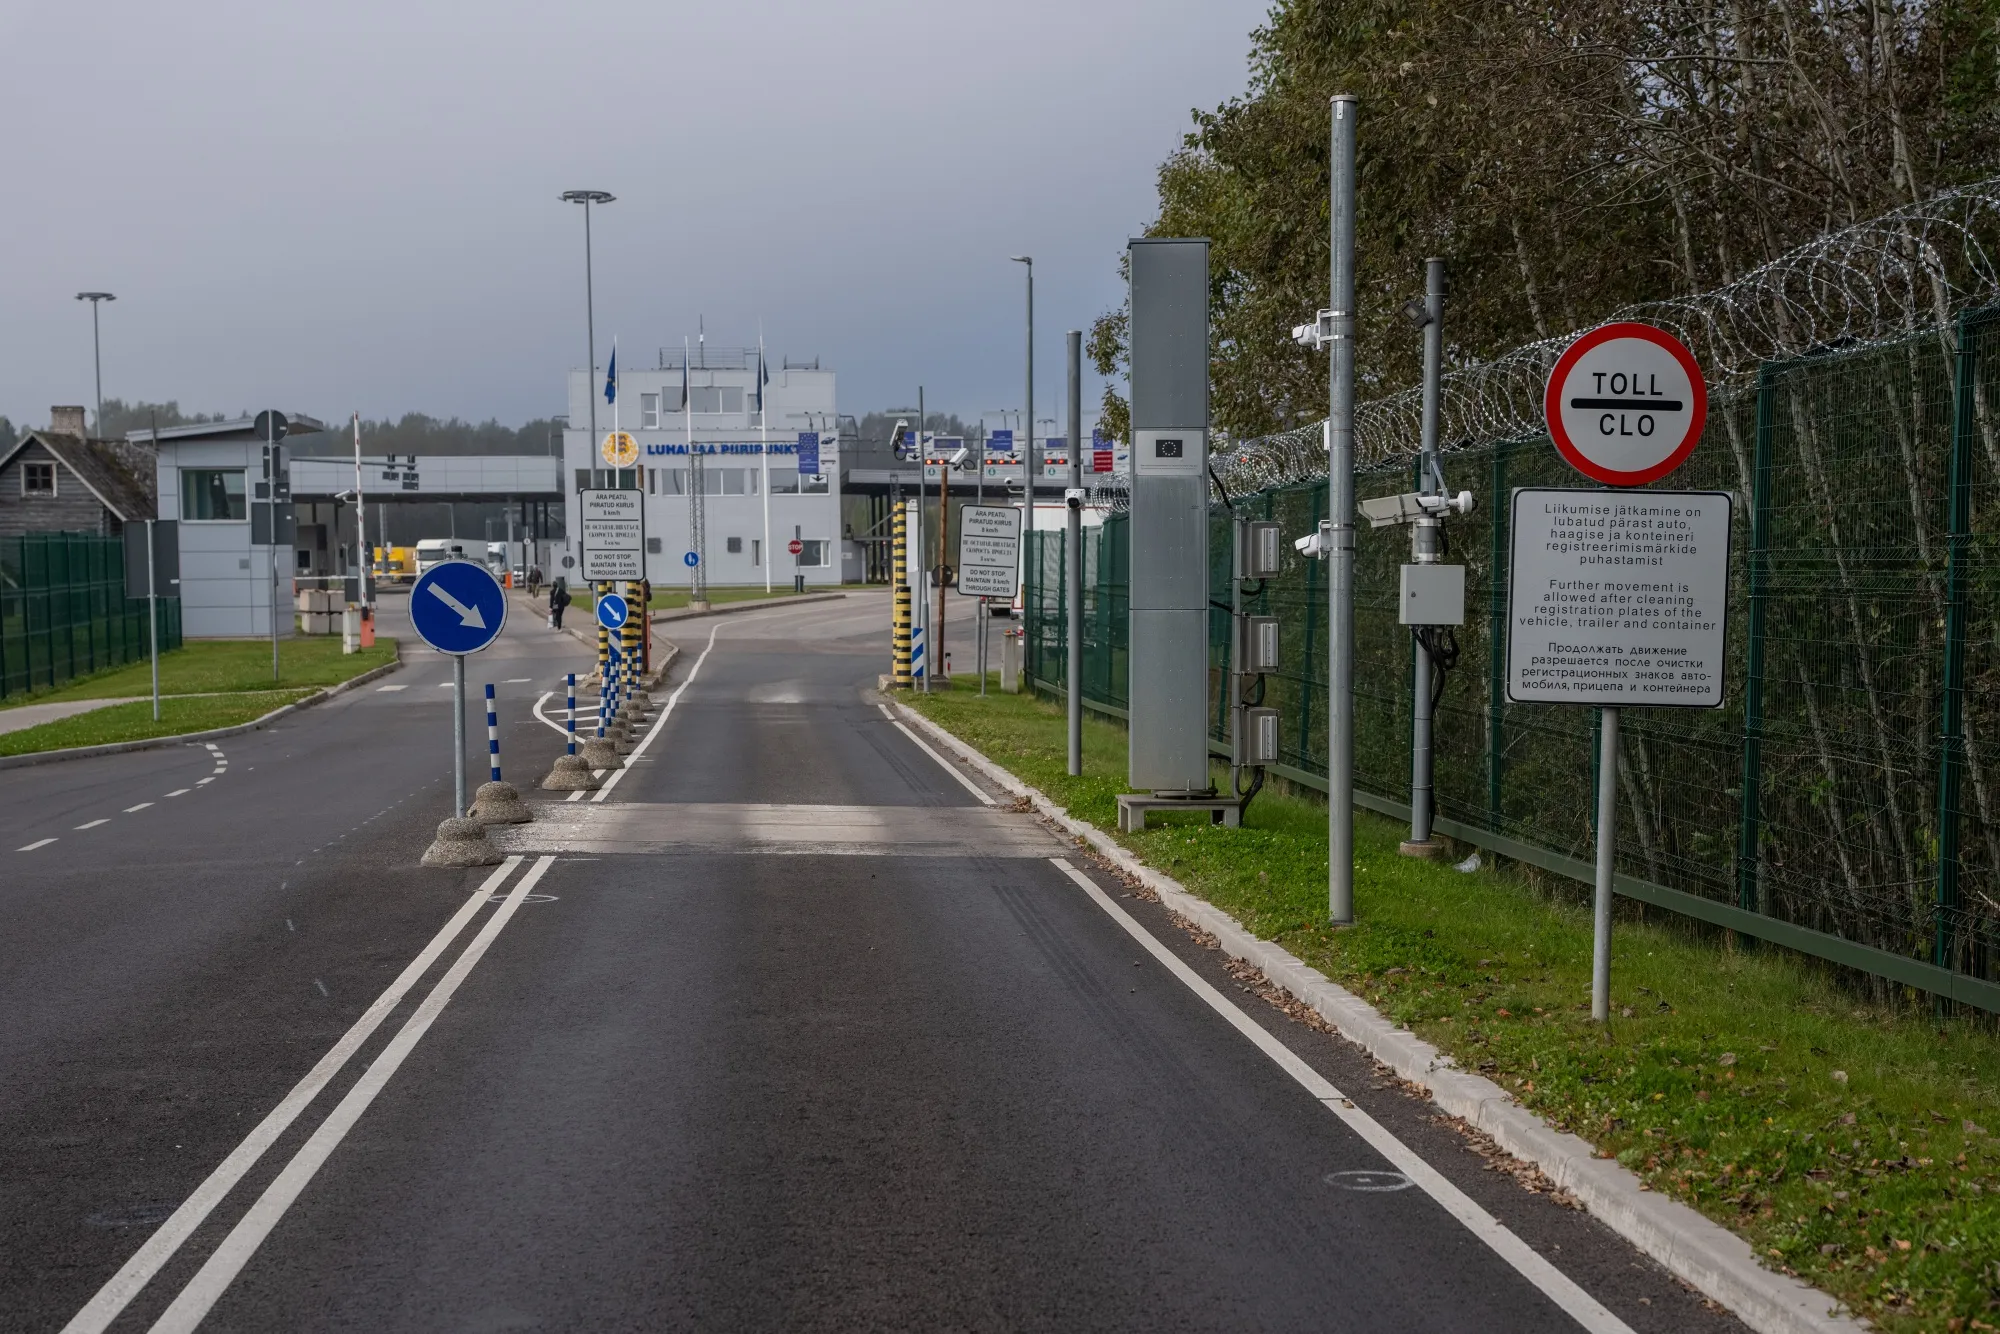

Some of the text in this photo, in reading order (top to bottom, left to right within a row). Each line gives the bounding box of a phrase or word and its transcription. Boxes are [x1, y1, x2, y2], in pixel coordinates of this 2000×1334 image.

[1593, 372, 1663, 396] TOLL
[1600, 414, 1654, 436] CLO
[1545, 504, 1701, 517] Liikumise jätkamine on
[1554, 517, 1691, 530] lubatud pärast auto,
[1550, 530, 1694, 542] haagise ja konteineri
[1546, 542, 1697, 554] registreerimismärkide
[1580, 555, 1663, 565] puhastamist
[1550, 580, 1689, 592] Further movement is
[1543, 593, 1694, 606] allowed after cleaning
[1534, 604, 1702, 617] registration plates of the
[1520, 616, 1716, 630] vehicle, trailer and container
[1548, 642, 1687, 655] Продолжать движение
[1531, 656, 1703, 668] разрешается после очистки
[1522, 668, 1711, 681] регистрационных знаков авто-
[1522, 680, 1711, 694] мобиля, прицепа и контейнера
